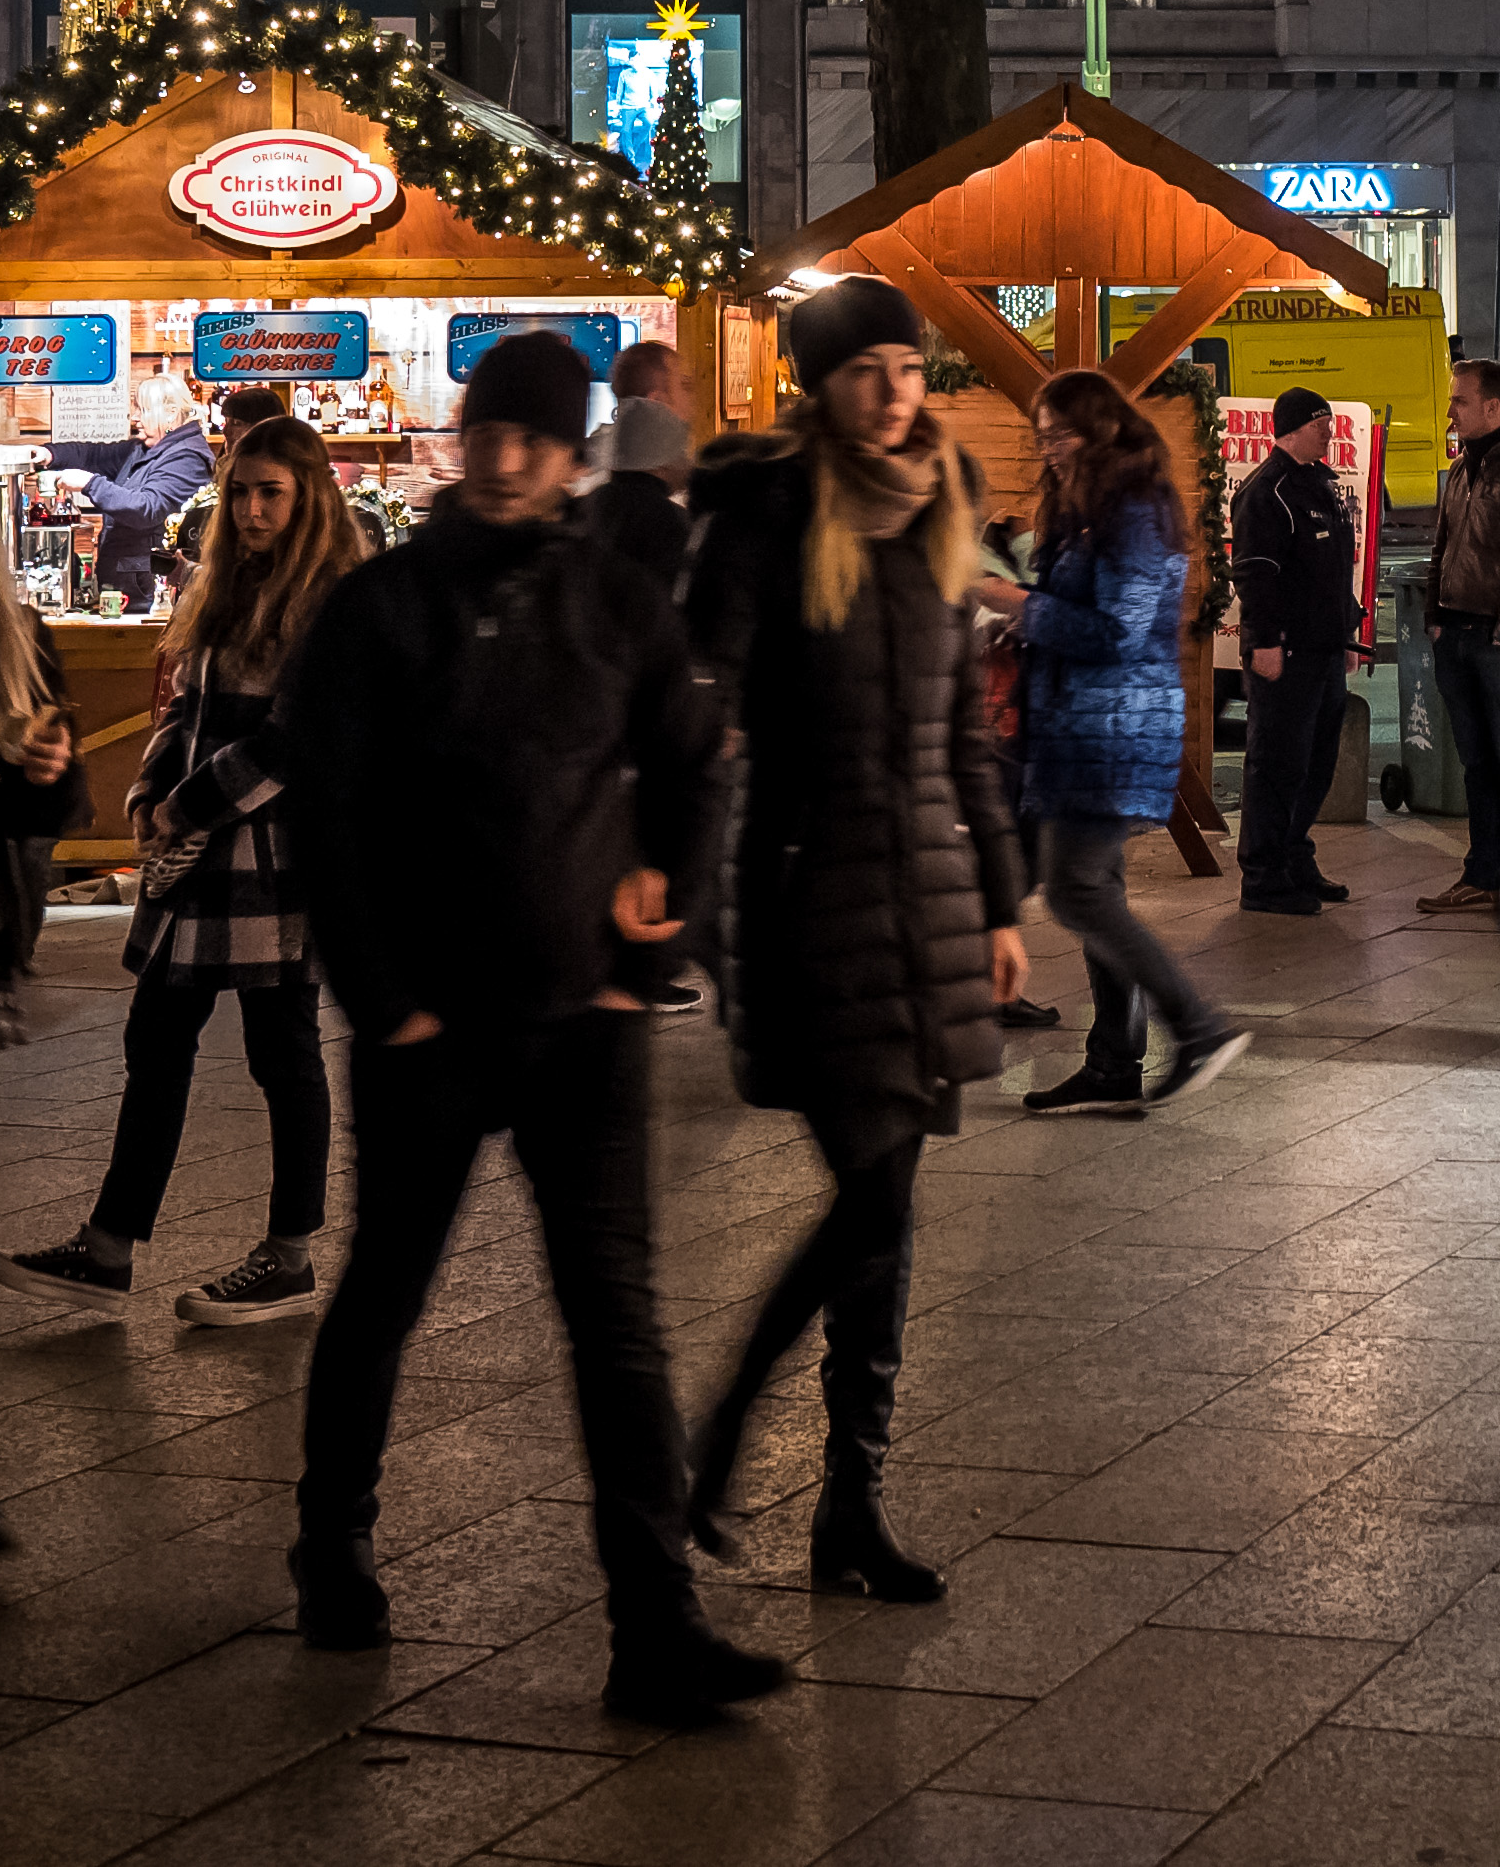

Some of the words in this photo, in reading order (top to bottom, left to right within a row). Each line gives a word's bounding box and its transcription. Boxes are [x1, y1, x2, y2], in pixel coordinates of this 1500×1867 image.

[252, 152, 309, 164] ORIGINAL
[220, 175, 342, 193] Christkindl
[1271, 169, 1389, 210] ZARA
[232, 200, 332, 217] Glühwein
[5, 358, 53, 376] TEE
